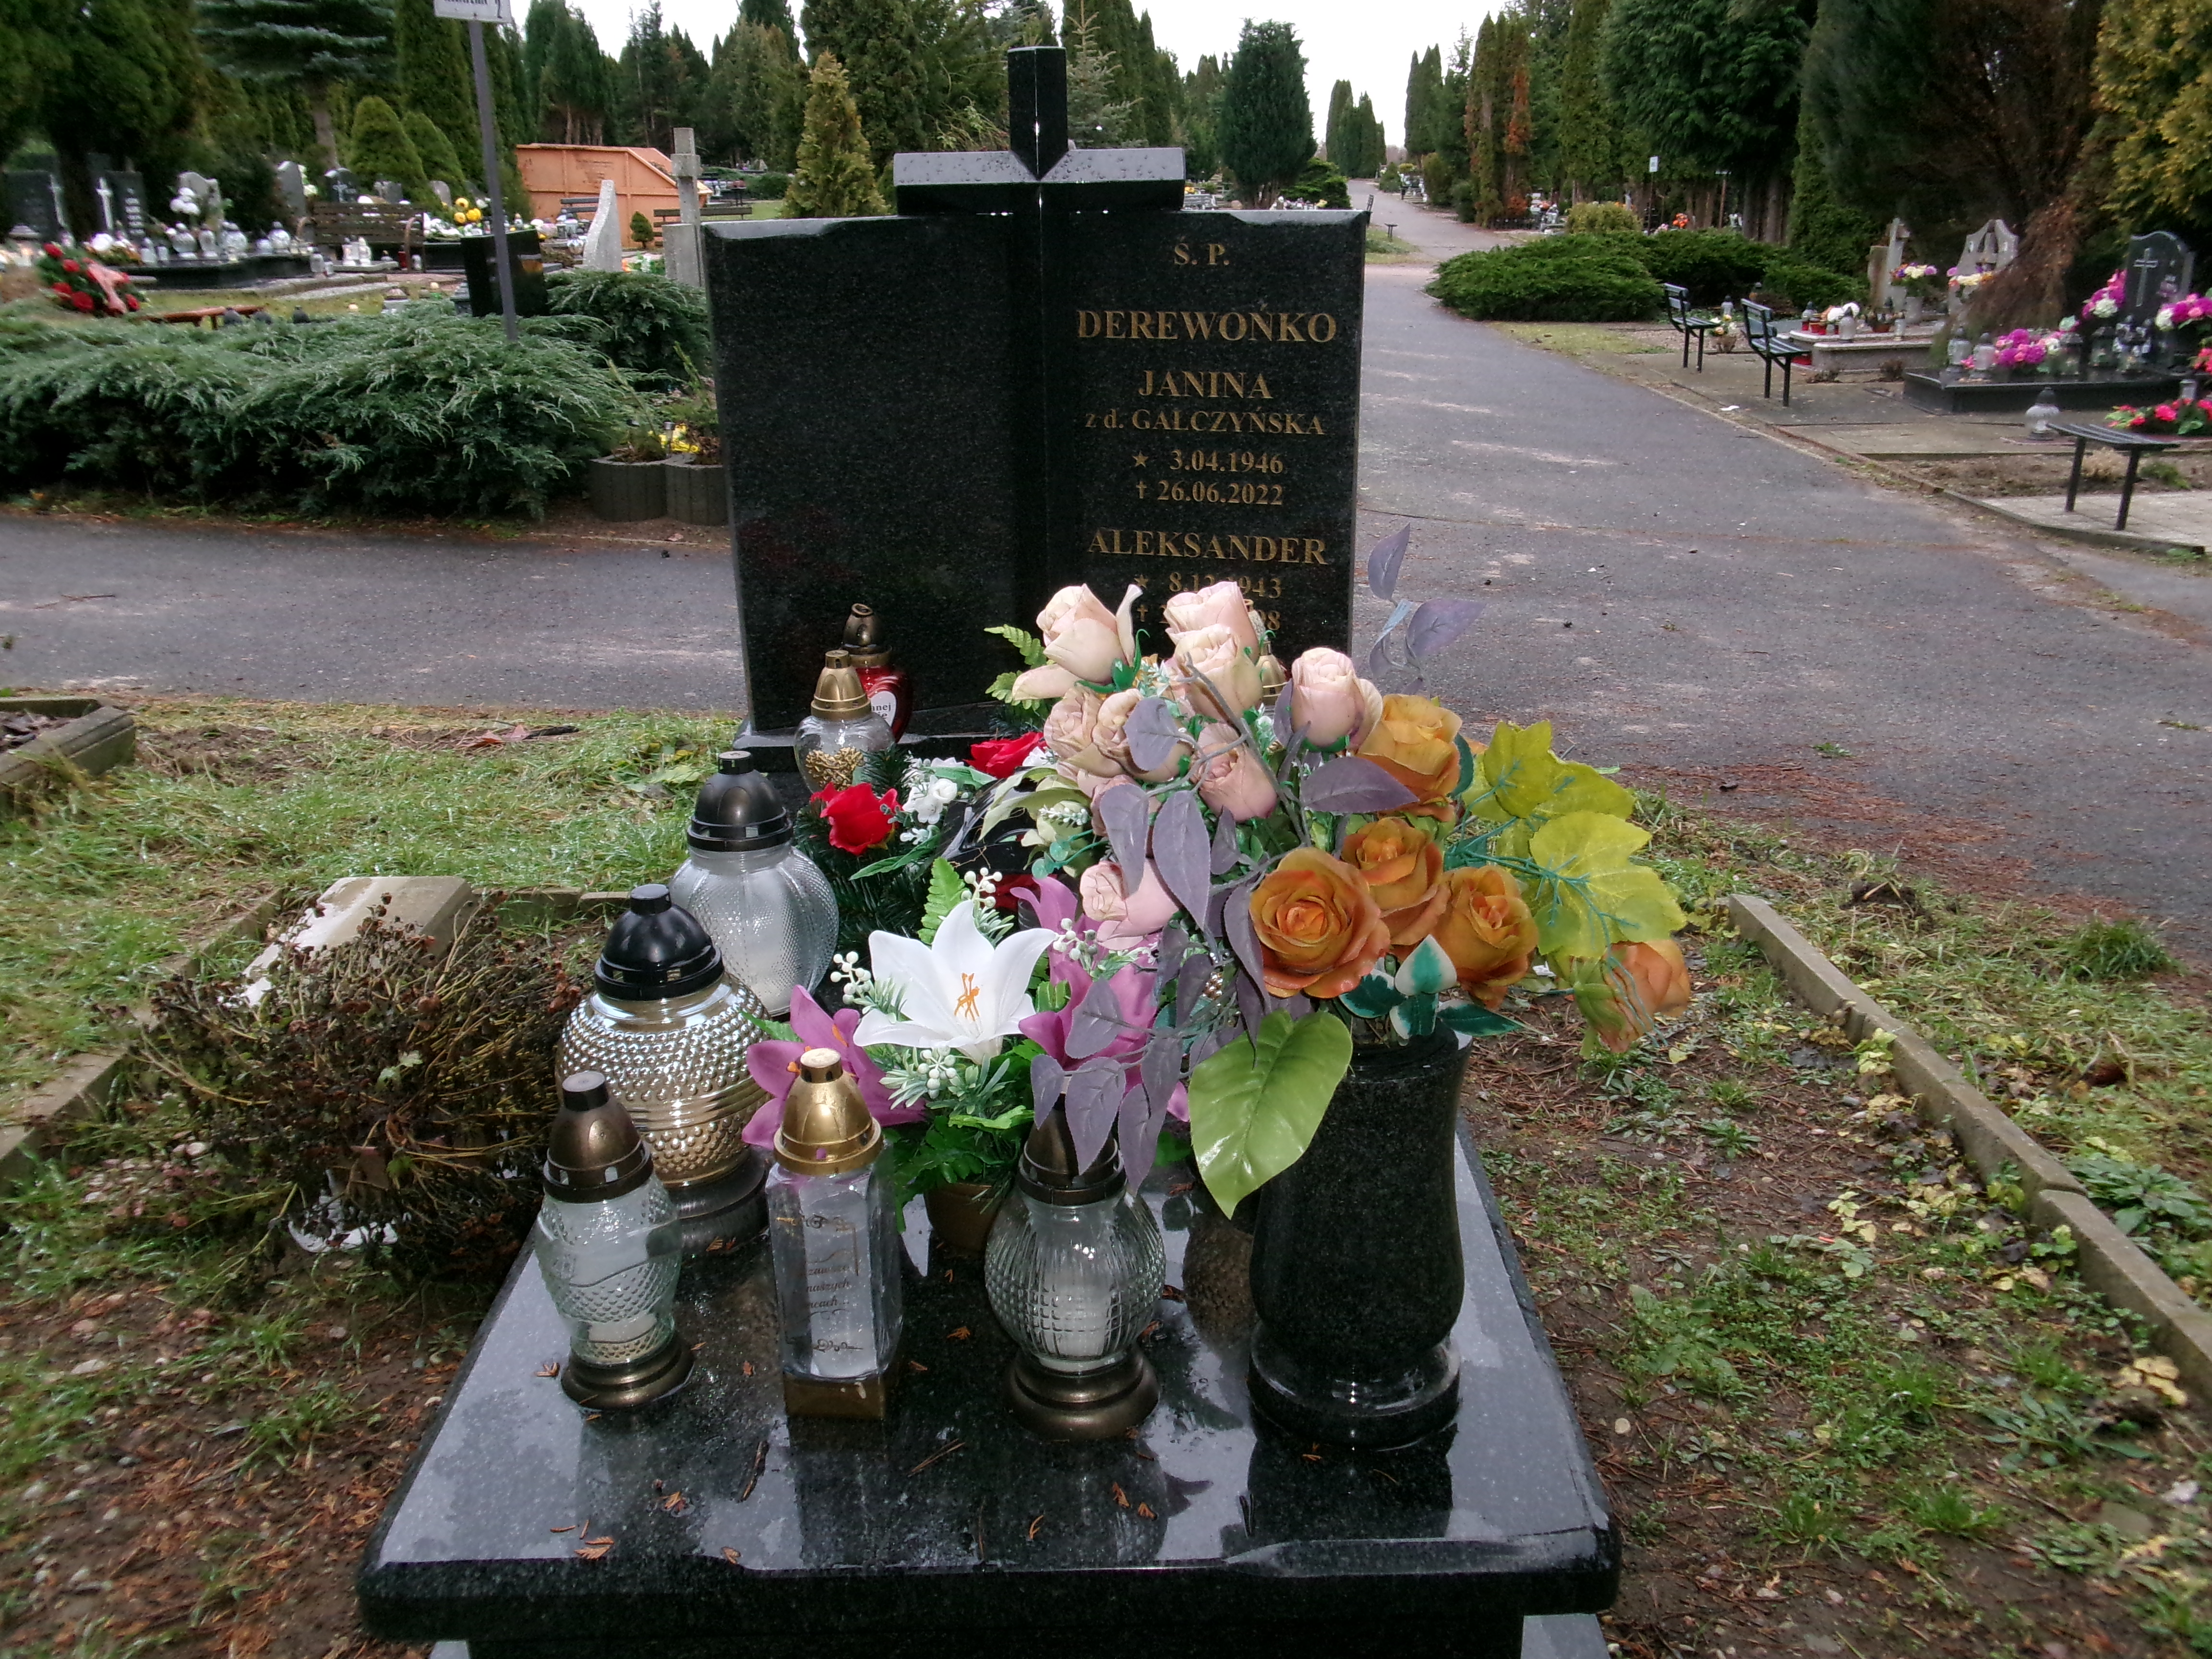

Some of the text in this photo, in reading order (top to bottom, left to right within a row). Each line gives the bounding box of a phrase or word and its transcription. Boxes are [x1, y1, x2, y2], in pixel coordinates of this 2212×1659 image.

[1208, 243, 1230, 265] P.
[1077, 303, 1337, 342] DEREWOŃKO
[1138, 370, 1274, 399] JANINA
[1104, 409, 1124, 428] d.
[1169, 449, 1283, 473] 3.04.1946
[1157, 480, 1283, 505] 26.06.2022
[1088, 527, 1328, 565] ALEKSANDER
[1169, 572, 1282, 598] 8.12943
